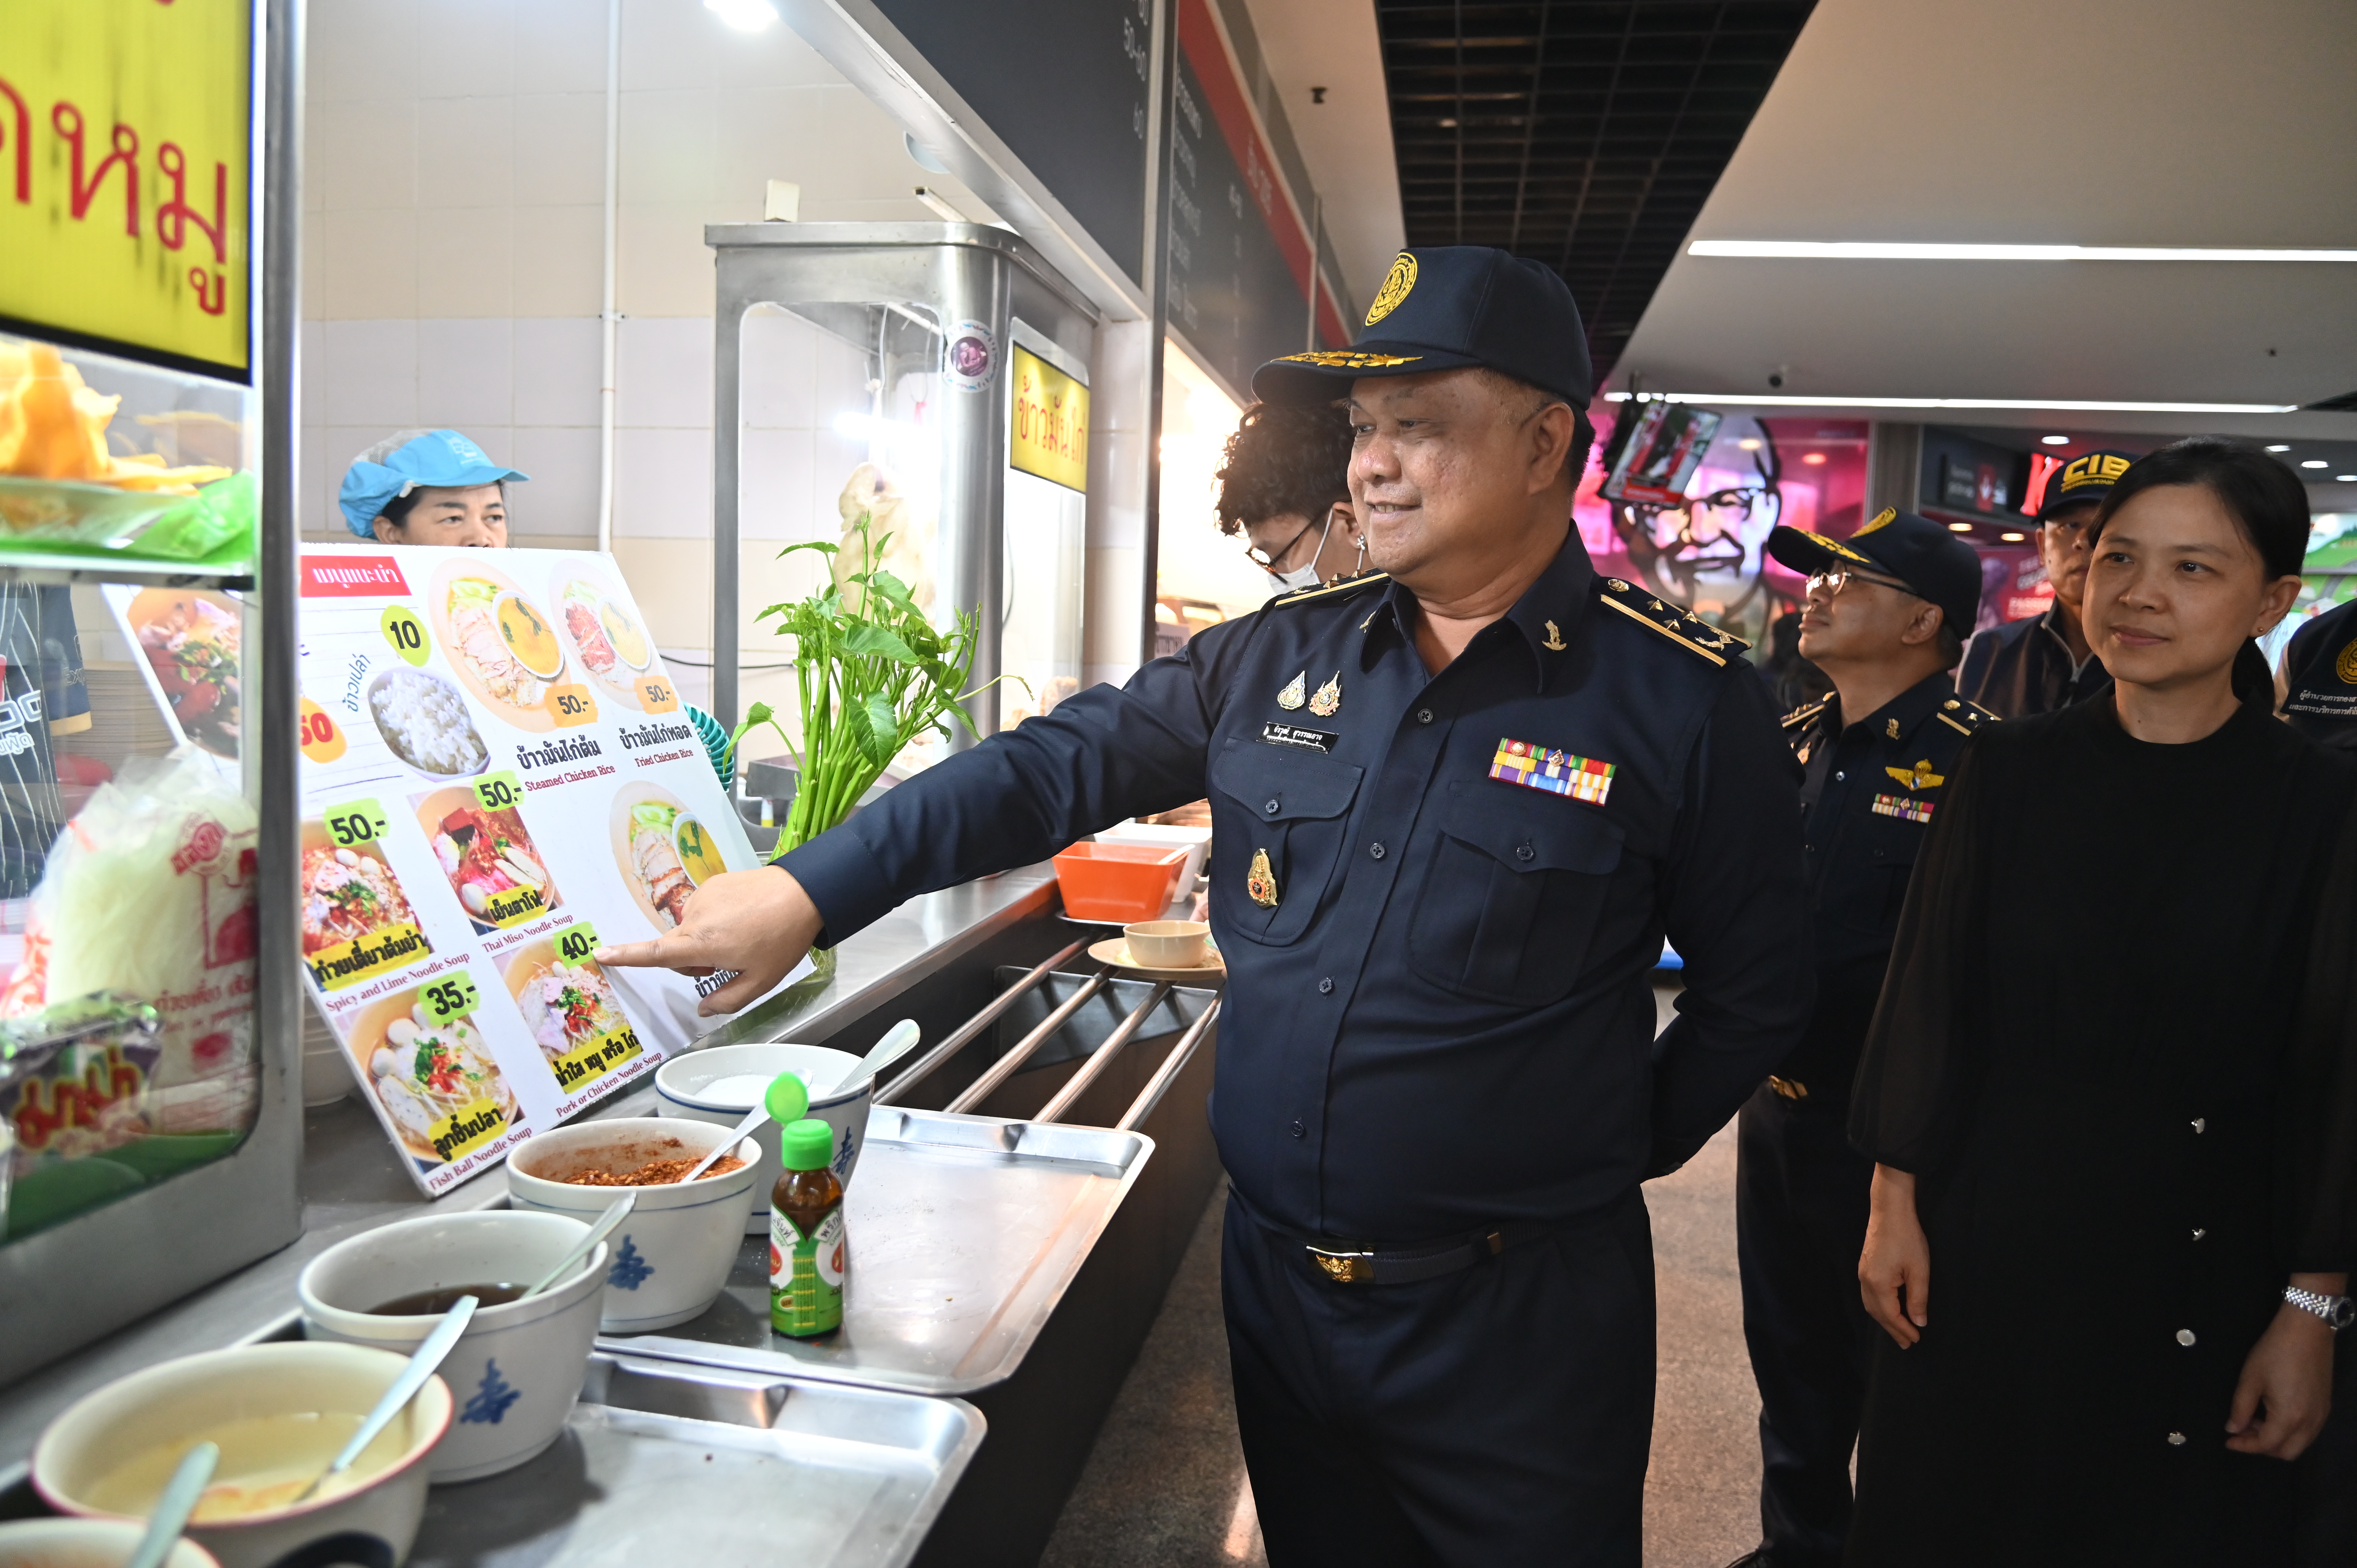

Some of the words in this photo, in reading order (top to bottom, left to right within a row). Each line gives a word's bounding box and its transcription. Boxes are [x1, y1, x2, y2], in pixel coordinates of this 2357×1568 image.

[1018, 375, 1086, 465] ข้าวมันไก่
[2063, 454, 2131, 482] CIB
[312, 563, 400, 588] เมนูแนะนำ
[390, 620, 421, 650] 10
[342, 653, 371, 712] ข้าวเปล่า
[645, 685, 671, 703] 50.-
[557, 694, 588, 715] 50.-
[516, 735, 602, 770] ข้าวมันไก่ต้ม
[619, 723, 693, 749] ข้าวมันไก่ทอด
[634, 755, 655, 767] Fried
[654, 752, 680, 763] Chicken
[678, 749, 694, 758] Rice
[479, 780, 522, 807] 50.-
[525, 774, 565, 791] Steamed
[564, 770, 599, 783] Chicken
[596, 765, 616, 775] Rice
[330, 813, 386, 845] 50.-
[490, 889, 544, 922] เย็นตาโฟ
[482, 938, 504, 953] Thai
[502, 932, 524, 945] Miso
[523, 921, 553, 938] Noodle
[552, 914, 574, 927] Soup
[325, 996, 358, 1012] Spicy
[360, 984, 382, 999] and
[380, 976, 409, 991] Lime
[408, 962, 445, 981] Noodle
[444, 953, 470, 967] Soup
[426, 980, 477, 1016] 35.-
[553, 1060, 586, 1086] น้ำใส
[584, 1052, 607, 1072] หมู
[601, 1038, 625, 1061] หรือ
[620, 1029, 640, 1049] ไก่
[556, 1100, 578, 1118] Pork
[578, 1094, 588, 1105] or
[587, 1076, 620, 1098] Chicken
[617, 1061, 644, 1081] Noodle
[643, 1052, 663, 1067] Soup
[433, 1108, 504, 1162] ลูกชิ้นปลา
[429, 1172, 454, 1190] Fish
[453, 1157, 475, 1176] Ball
[473, 1141, 508, 1165] Noodle
[507, 1127, 533, 1145] Soup
